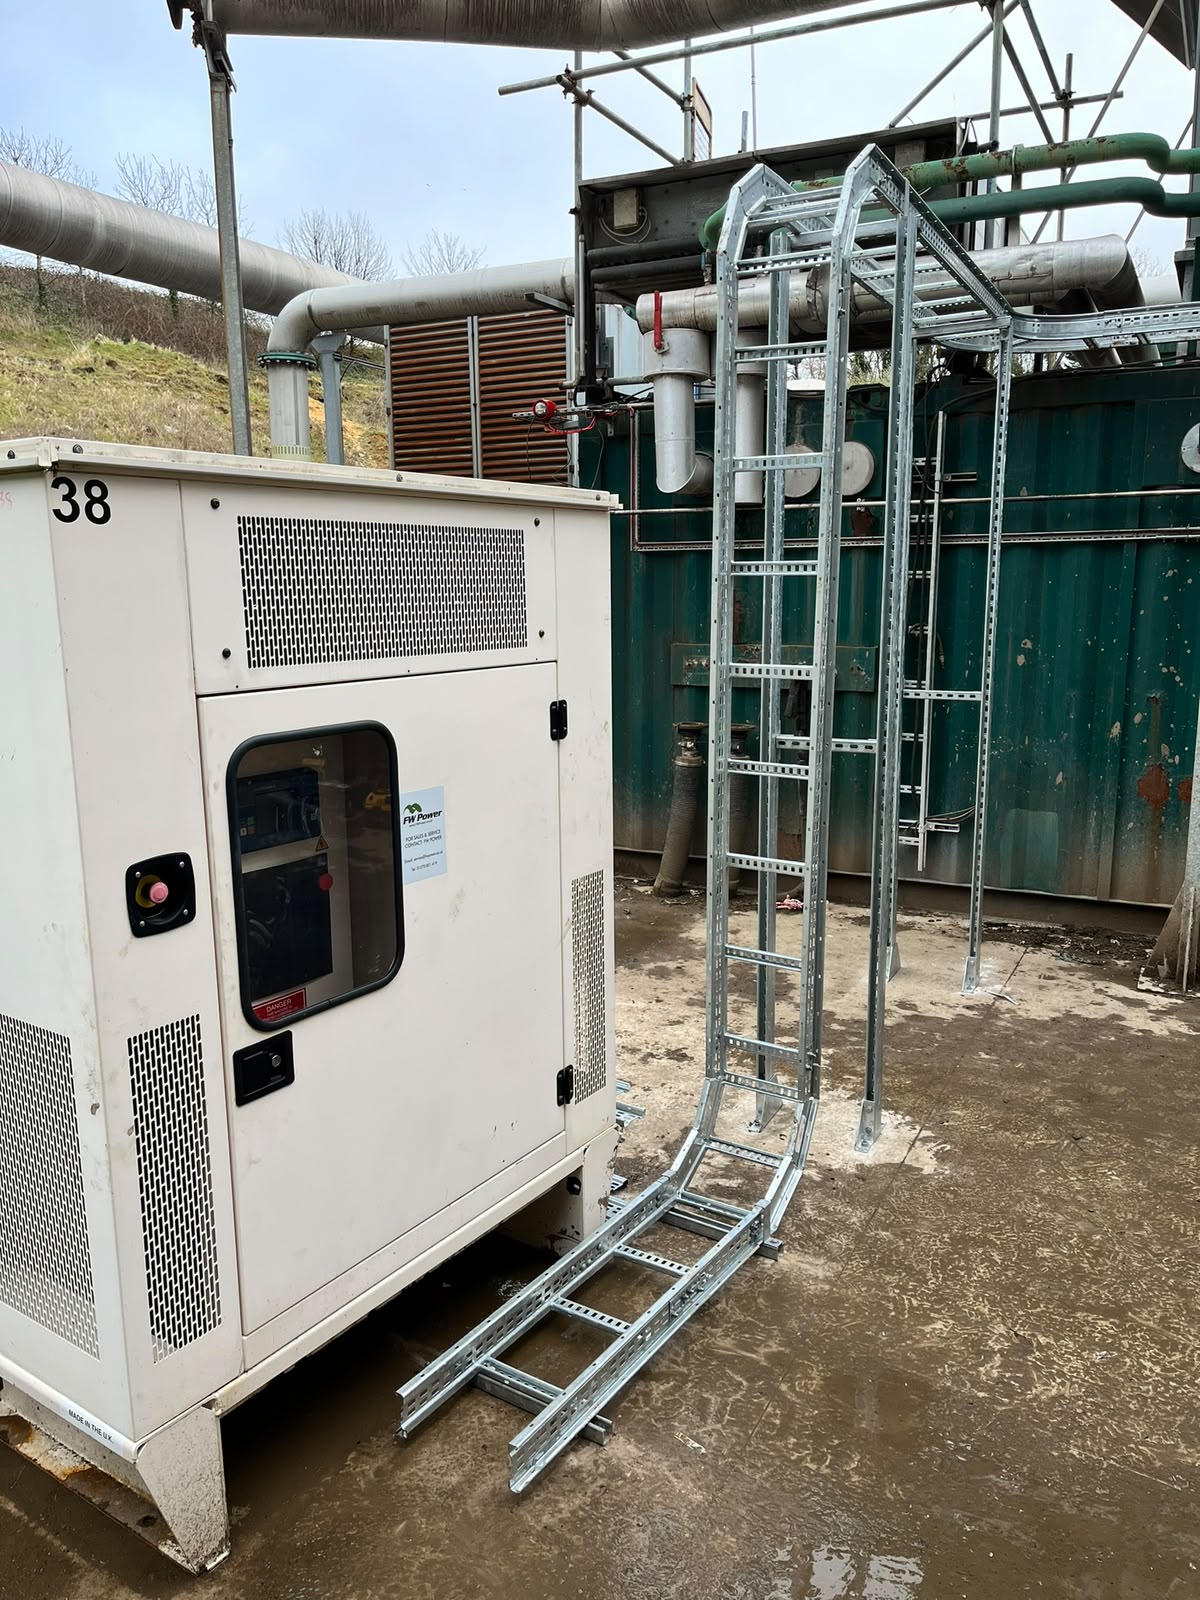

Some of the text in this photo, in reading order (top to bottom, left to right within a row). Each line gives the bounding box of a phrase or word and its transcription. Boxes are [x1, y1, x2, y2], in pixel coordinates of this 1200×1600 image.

[51, 476, 111, 525] 38
[403, 815, 417, 825] FW
[417, 810, 442, 822] Power
[266, 999, 292, 1013] DANGER
[68, 1409, 84, 1425] MADE
[84, 1420, 91, 1428] IN
[91, 1424, 102, 1436] THE
